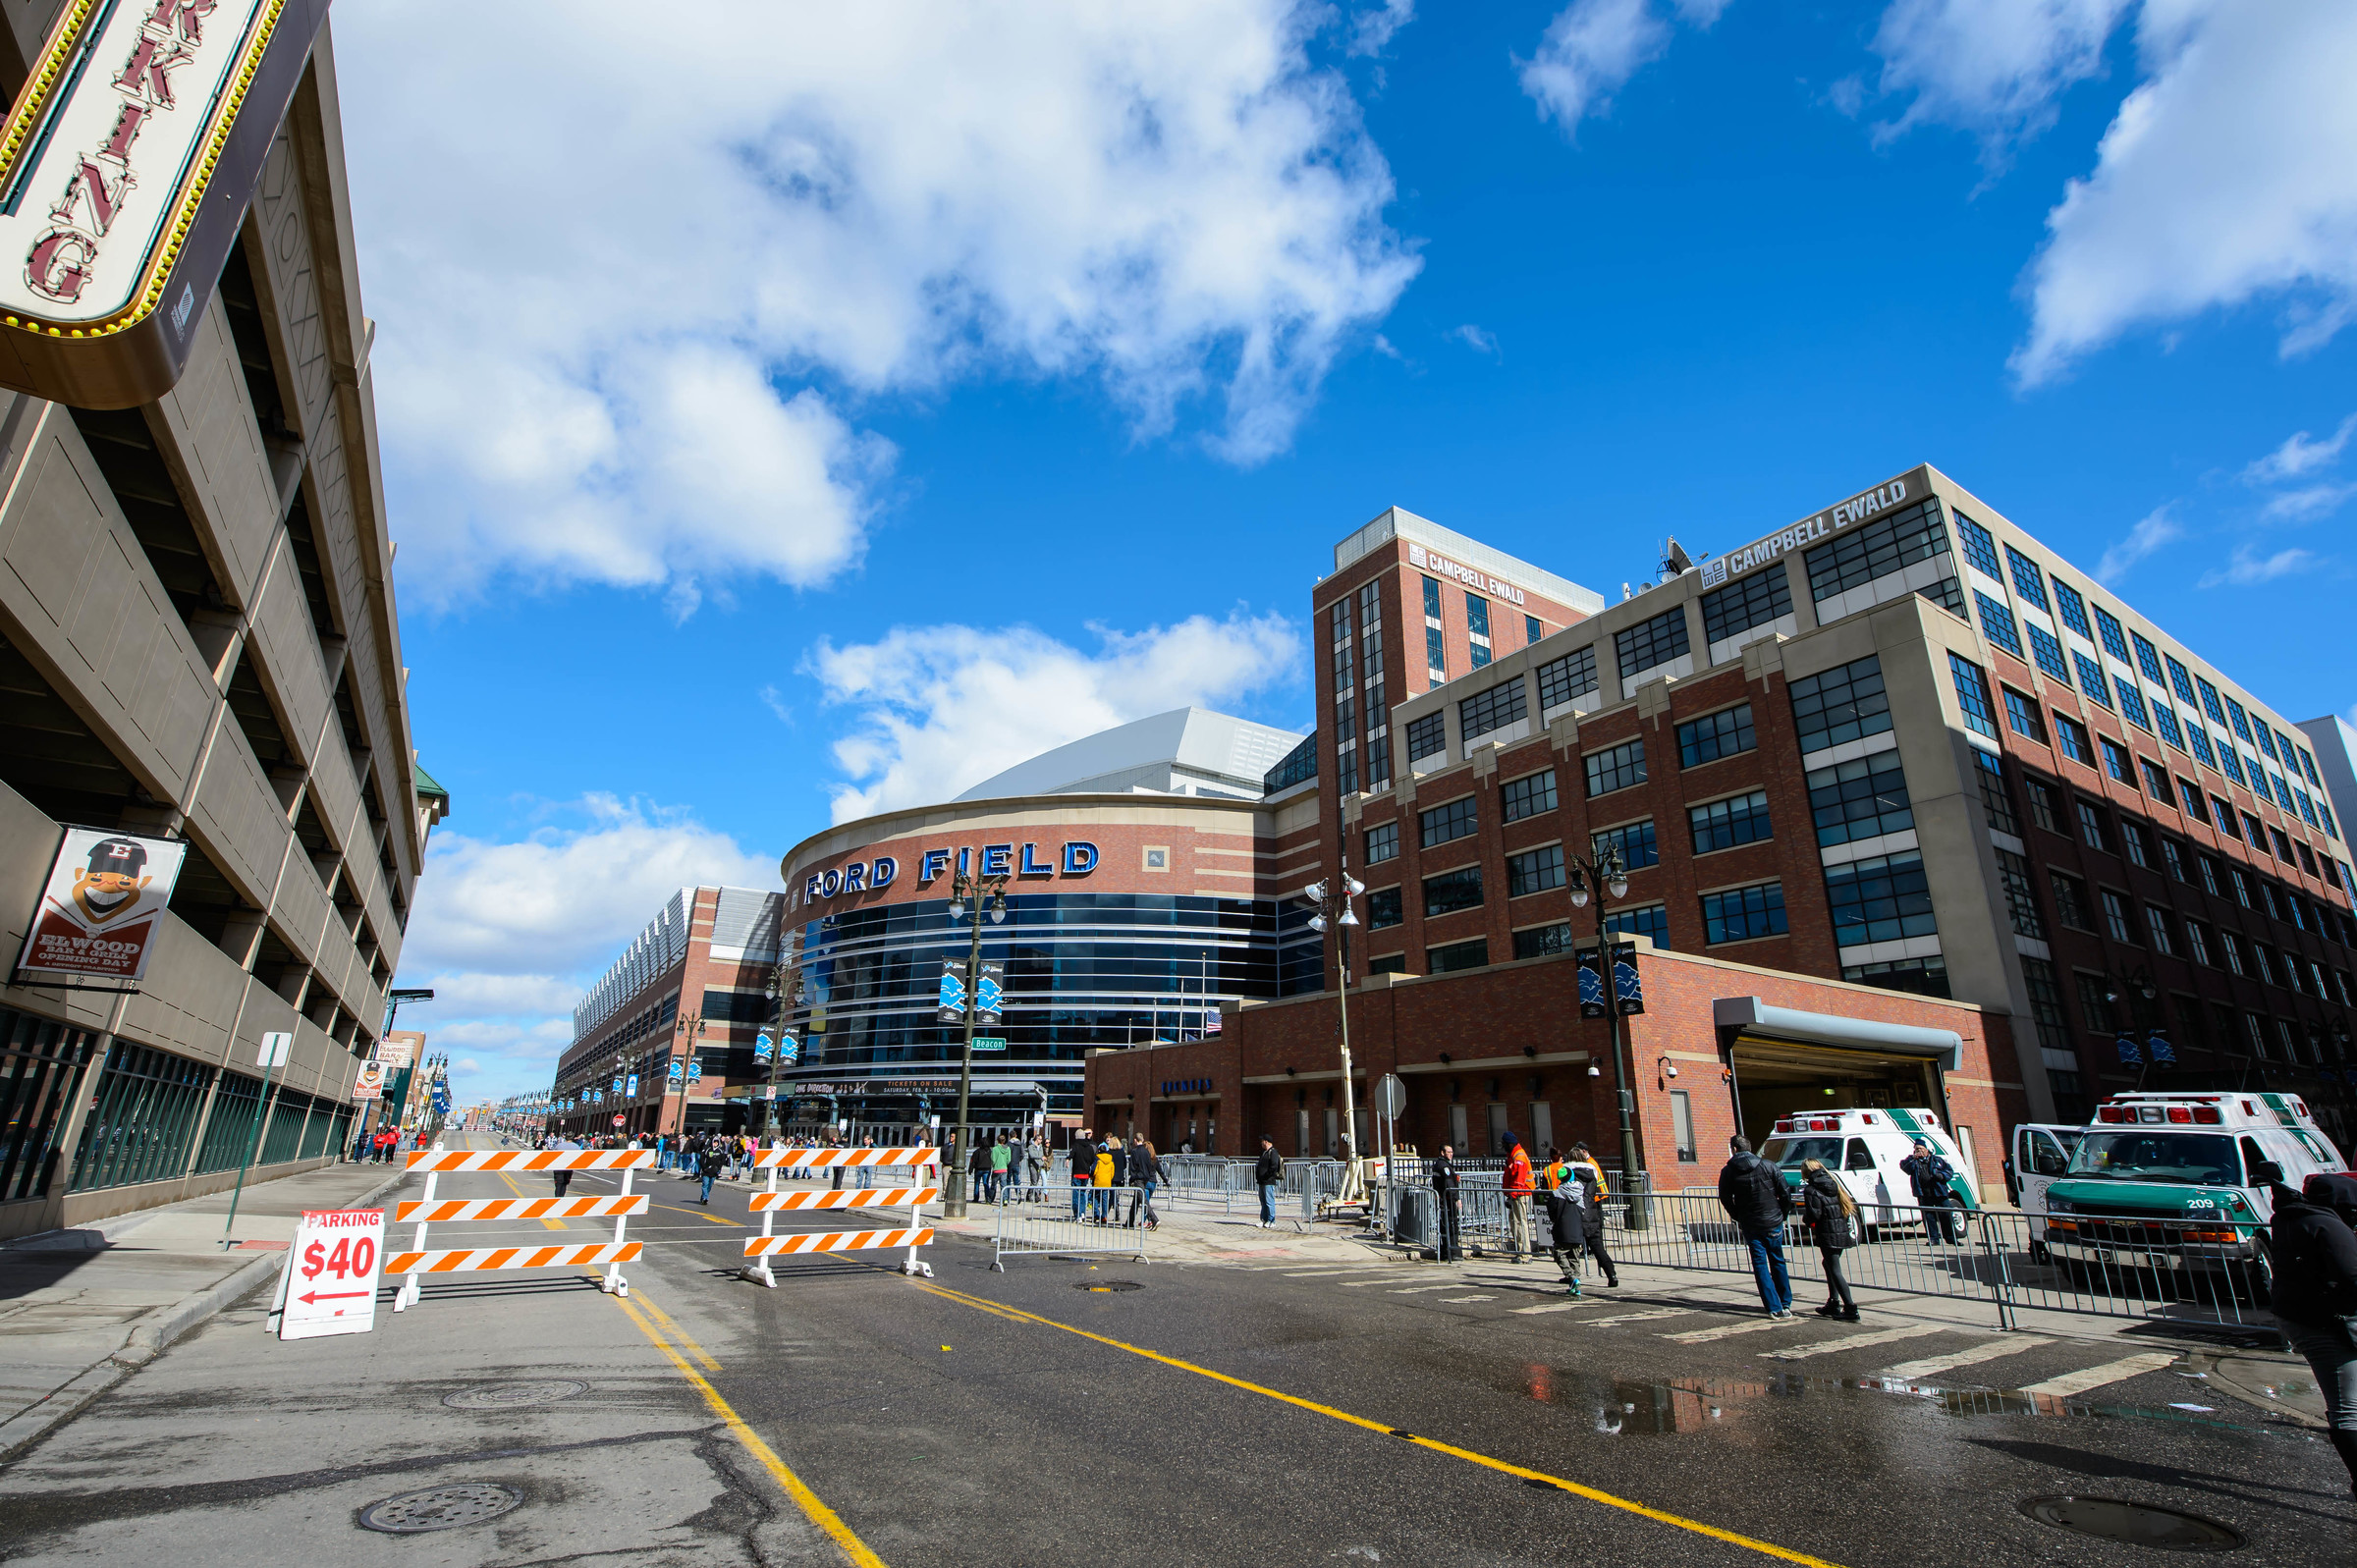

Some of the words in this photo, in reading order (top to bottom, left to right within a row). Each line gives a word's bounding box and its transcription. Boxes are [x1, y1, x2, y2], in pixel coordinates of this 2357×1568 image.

[1730, 515, 1830, 573] CAMPBELL
[1833, 480, 1907, 529] EWALD
[1429, 554, 1488, 592] CAMPBELL
[1489, 577, 1524, 606] EWALD
[109, 843, 133, 860] E
[803, 856, 900, 905] FORD
[920, 840, 1101, 882] FIELD
[39, 934, 140, 954] ELWOOD
[38, 952, 99, 965] OPENING
[102, 958, 132, 968] DAY
[45, 946, 75, 955] BAR
[78, 947, 85, 956] &
[89, 949, 129, 960] GRILL
[976, 1039, 1003, 1049] Beacon
[2186, 1199, 2215, 1209] 209
[307, 1213, 380, 1228] PARKING
[301, 1236, 375, 1282] $40
